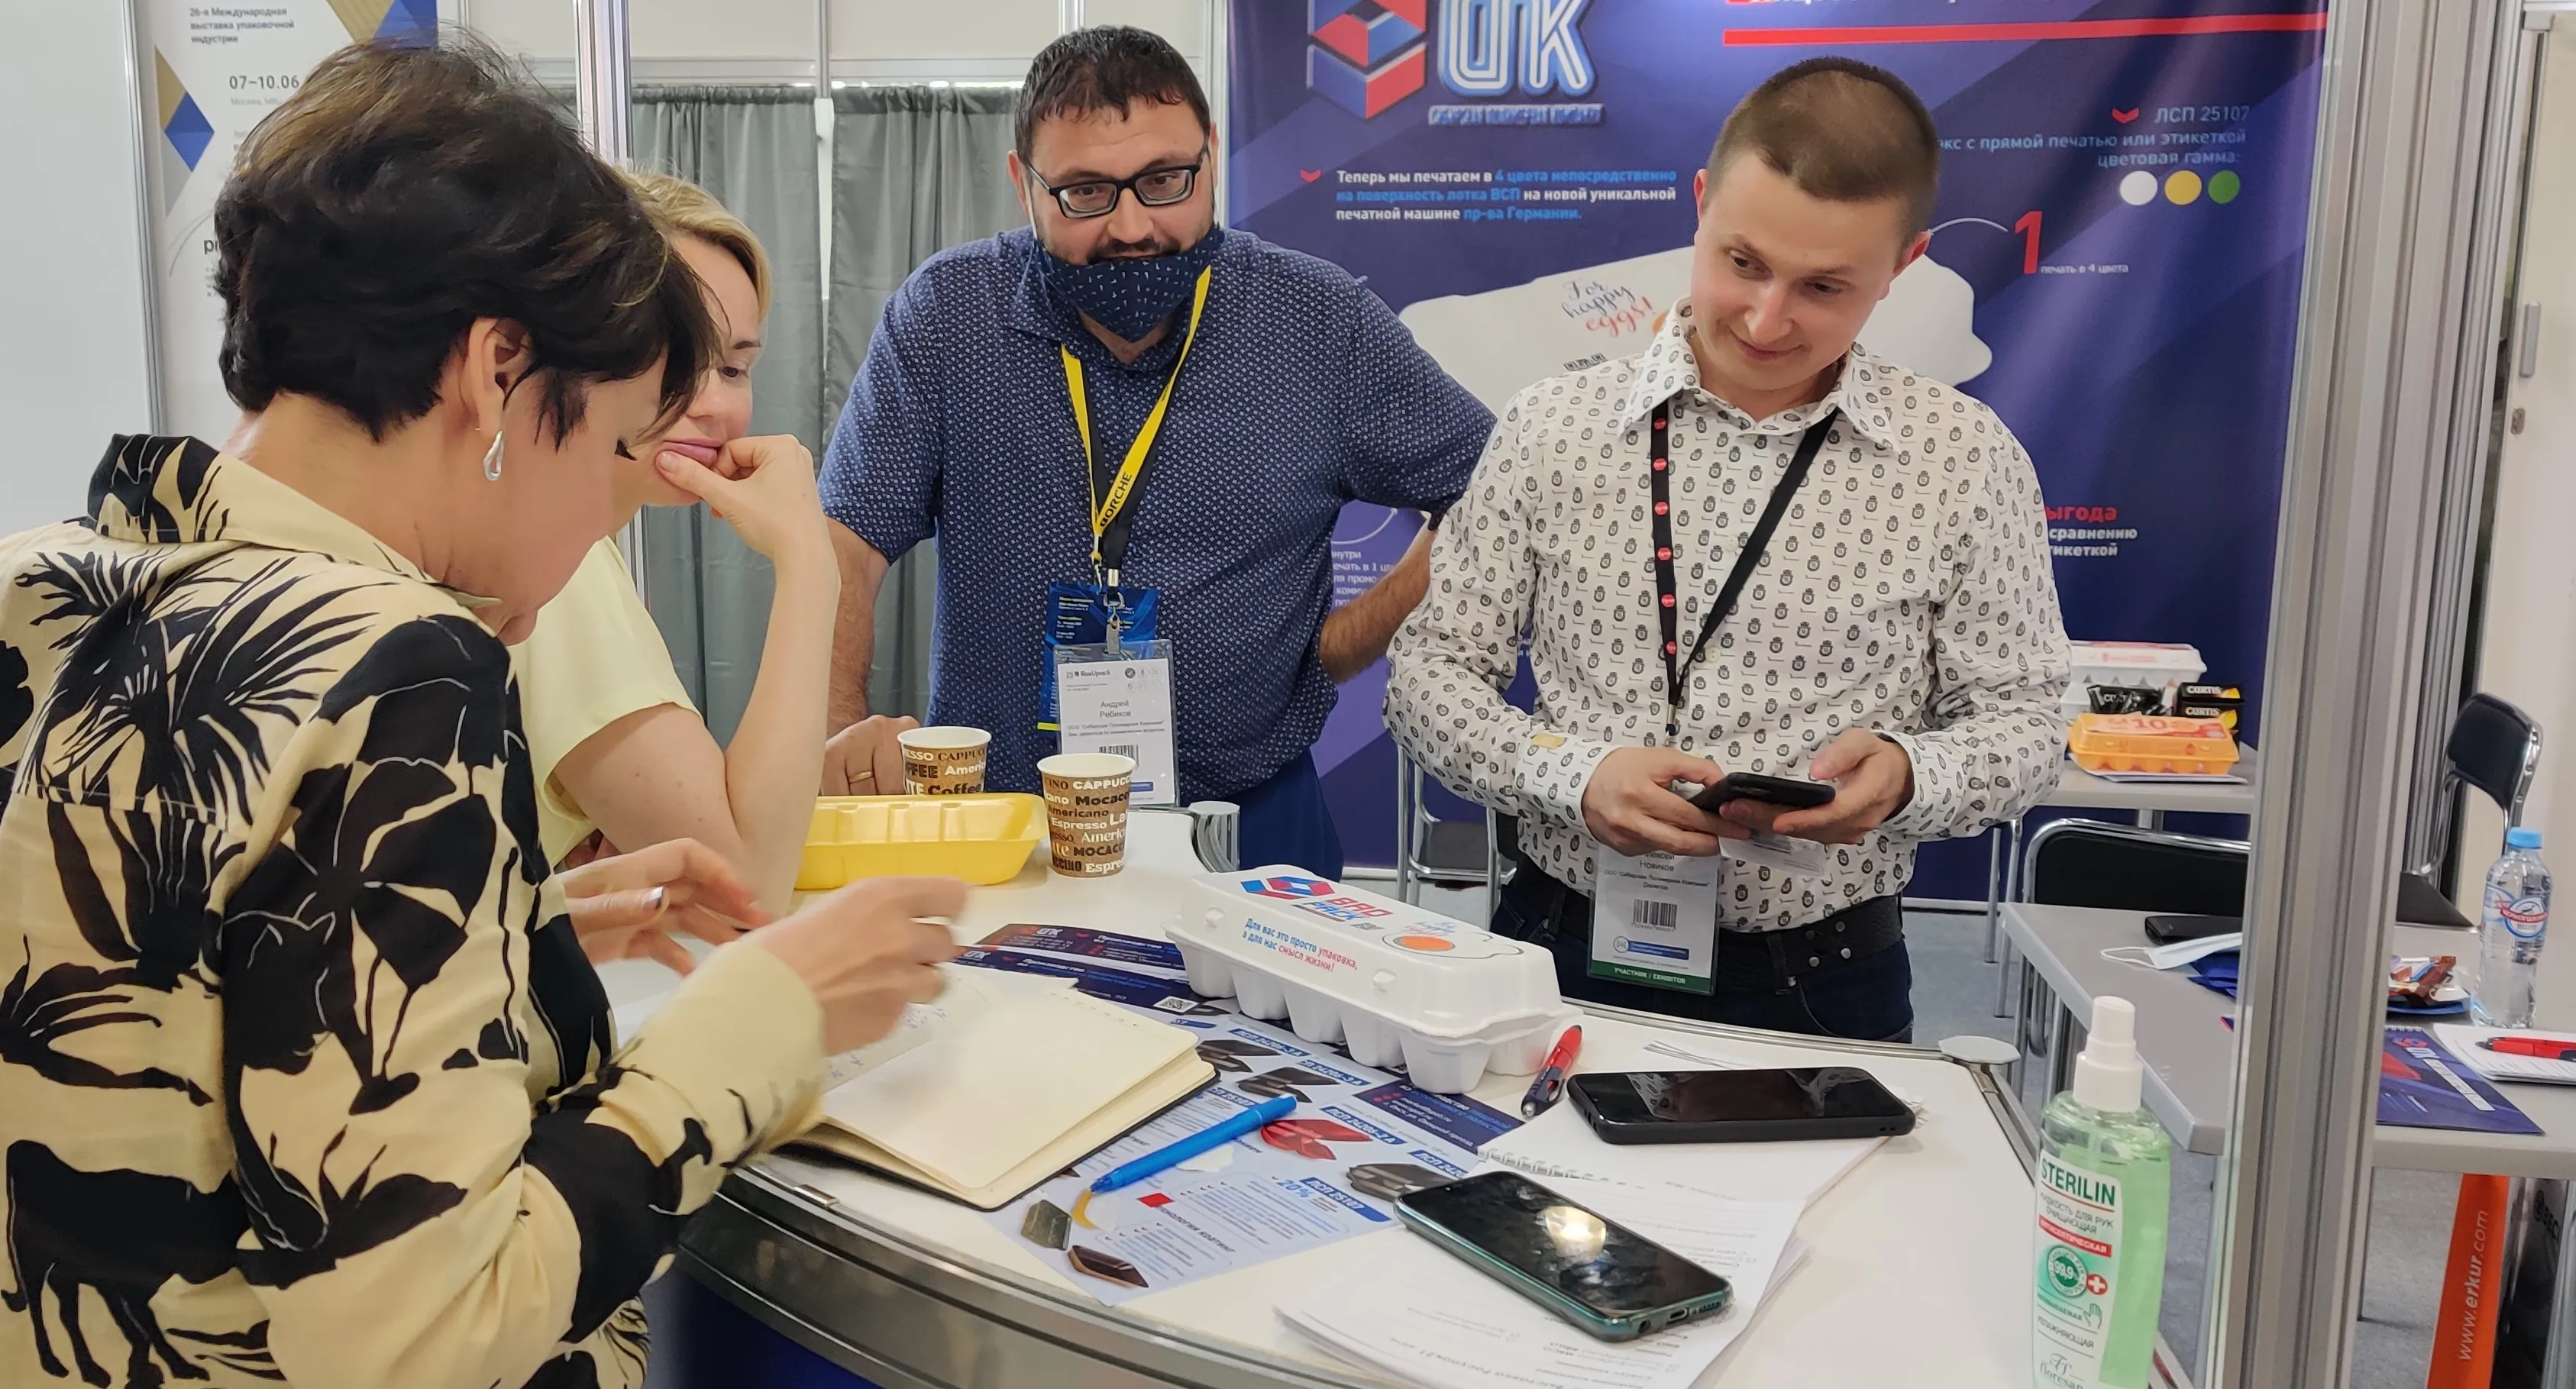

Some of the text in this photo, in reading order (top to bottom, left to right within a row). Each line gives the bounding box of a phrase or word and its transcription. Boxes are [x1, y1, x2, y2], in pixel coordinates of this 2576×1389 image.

[212, 8, 287, 18] Международная
[190, 20, 294, 31] выставка упаковочной
[2154, 105, 2250, 123] ЛСП 25107
[1966, 138, 1976, 150] с
[1980, 134, 2044, 153] прямой
[2048, 134, 2118, 149] печатью
[2122, 134, 2155, 146] или
[2161, 129, 2246, 146] этикеткой
[2098, 153, 2179, 169] цветовая
[1336, 170, 1676, 186] Теперь мы печатаем в 4 цвета непосредственно
[1336, 191, 1353, 202] на
[1356, 190, 1445, 203] поверхность
[1446, 189, 1488, 201] лотка
[1524, 189, 1540, 201] на
[1544, 187, 1588, 201] новой
[1589, 186, 1676, 204] уникальной
[1336, 206, 1401, 220] печатной
[1403, 208, 1461, 220] машине
[2015, 211, 2043, 274] 1
[1561, 286, 1636, 318] happy
[1100, 473, 1133, 528] BORCHE
[2045, 506, 2118, 524] ыгода
[2049, 528, 2138, 542] сравнению
[2049, 541, 2119, 557] икеткой
[1333, 563, 1361, 572] ечать
[1101, 700, 1130, 709] Андрей
[1048, 804, 1109, 819] Americano
[1051, 816, 1107, 831] Espresso
[1245, 918, 1357, 971] Для вас это просто упаковка,
[1248, 932, 1262, 945] для
[1263, 938, 1278, 951] нас
[1278, 944, 1304, 962] смысл
[1304, 952, 1335, 973] жизни!
[2041, 1157, 2115, 1206] STERILIN
[2075, 1210, 2093, 1223] ДЛЯ
[2096, 1216, 2114, 1229] РУК
[2458, 1210, 2489, 1361] www.erkur.com
